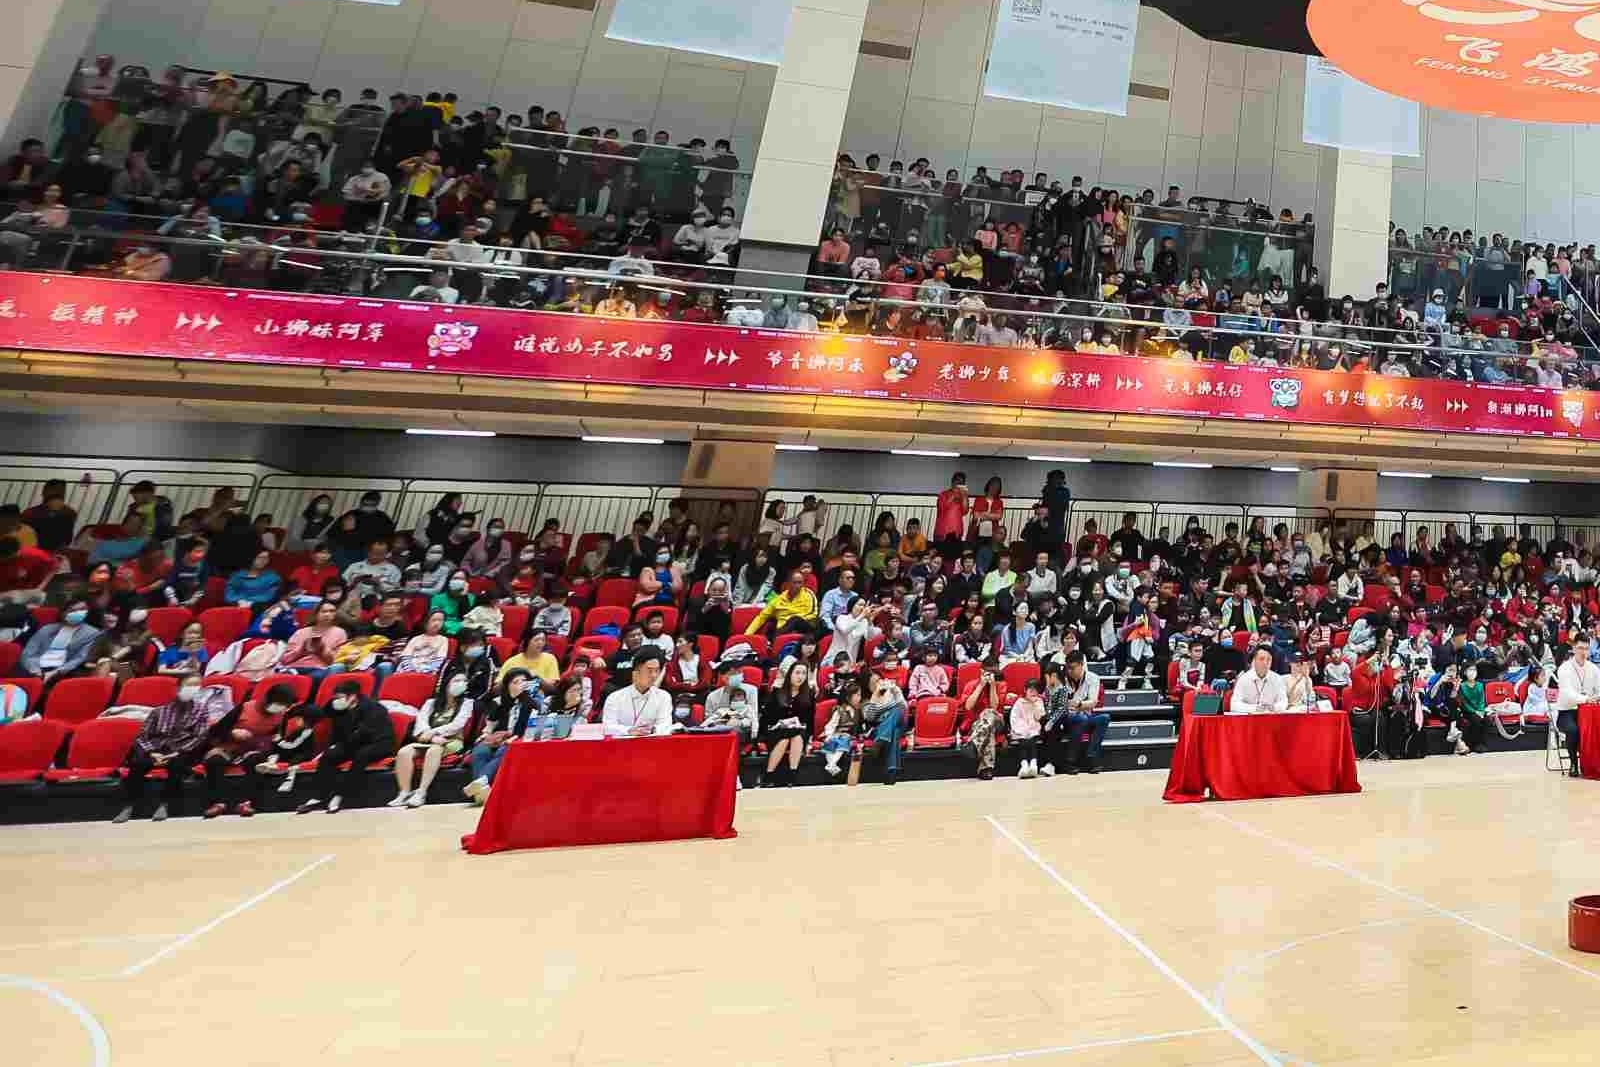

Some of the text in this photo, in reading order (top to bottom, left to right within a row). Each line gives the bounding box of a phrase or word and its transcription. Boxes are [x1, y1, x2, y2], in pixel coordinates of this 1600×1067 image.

[512, 334, 674, 362] 谁说女子不如男
